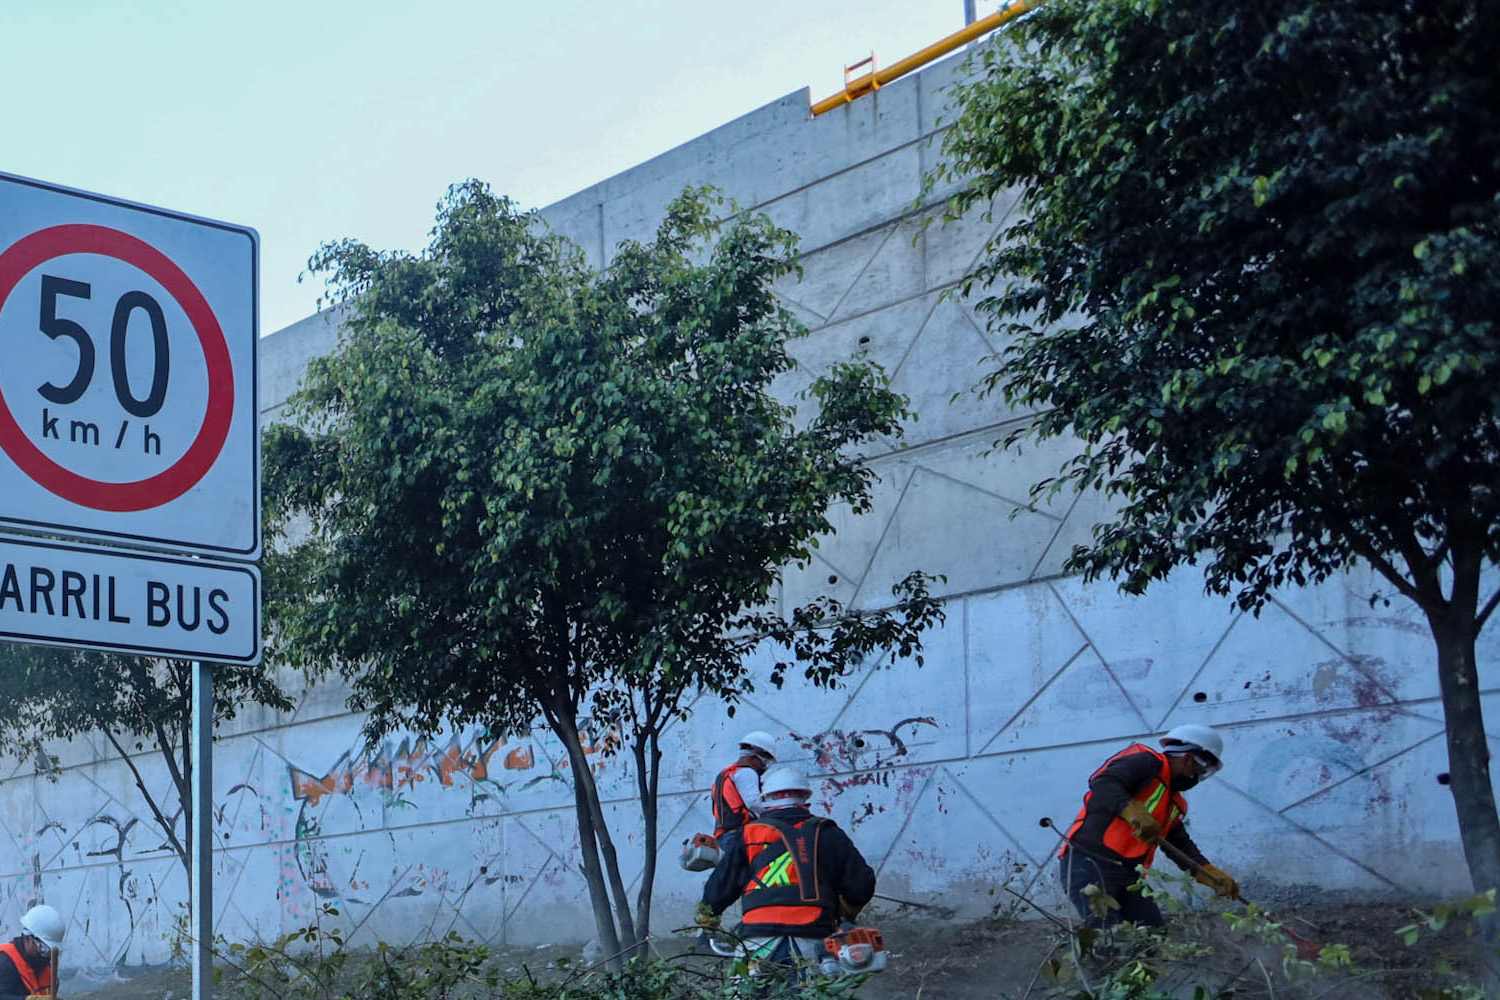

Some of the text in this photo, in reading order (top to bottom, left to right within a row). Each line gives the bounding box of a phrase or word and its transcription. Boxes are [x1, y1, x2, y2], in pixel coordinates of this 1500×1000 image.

[36, 273, 170, 418] 50
[42, 407, 161, 456] km/h
[146, 580, 231, 636] BUS
